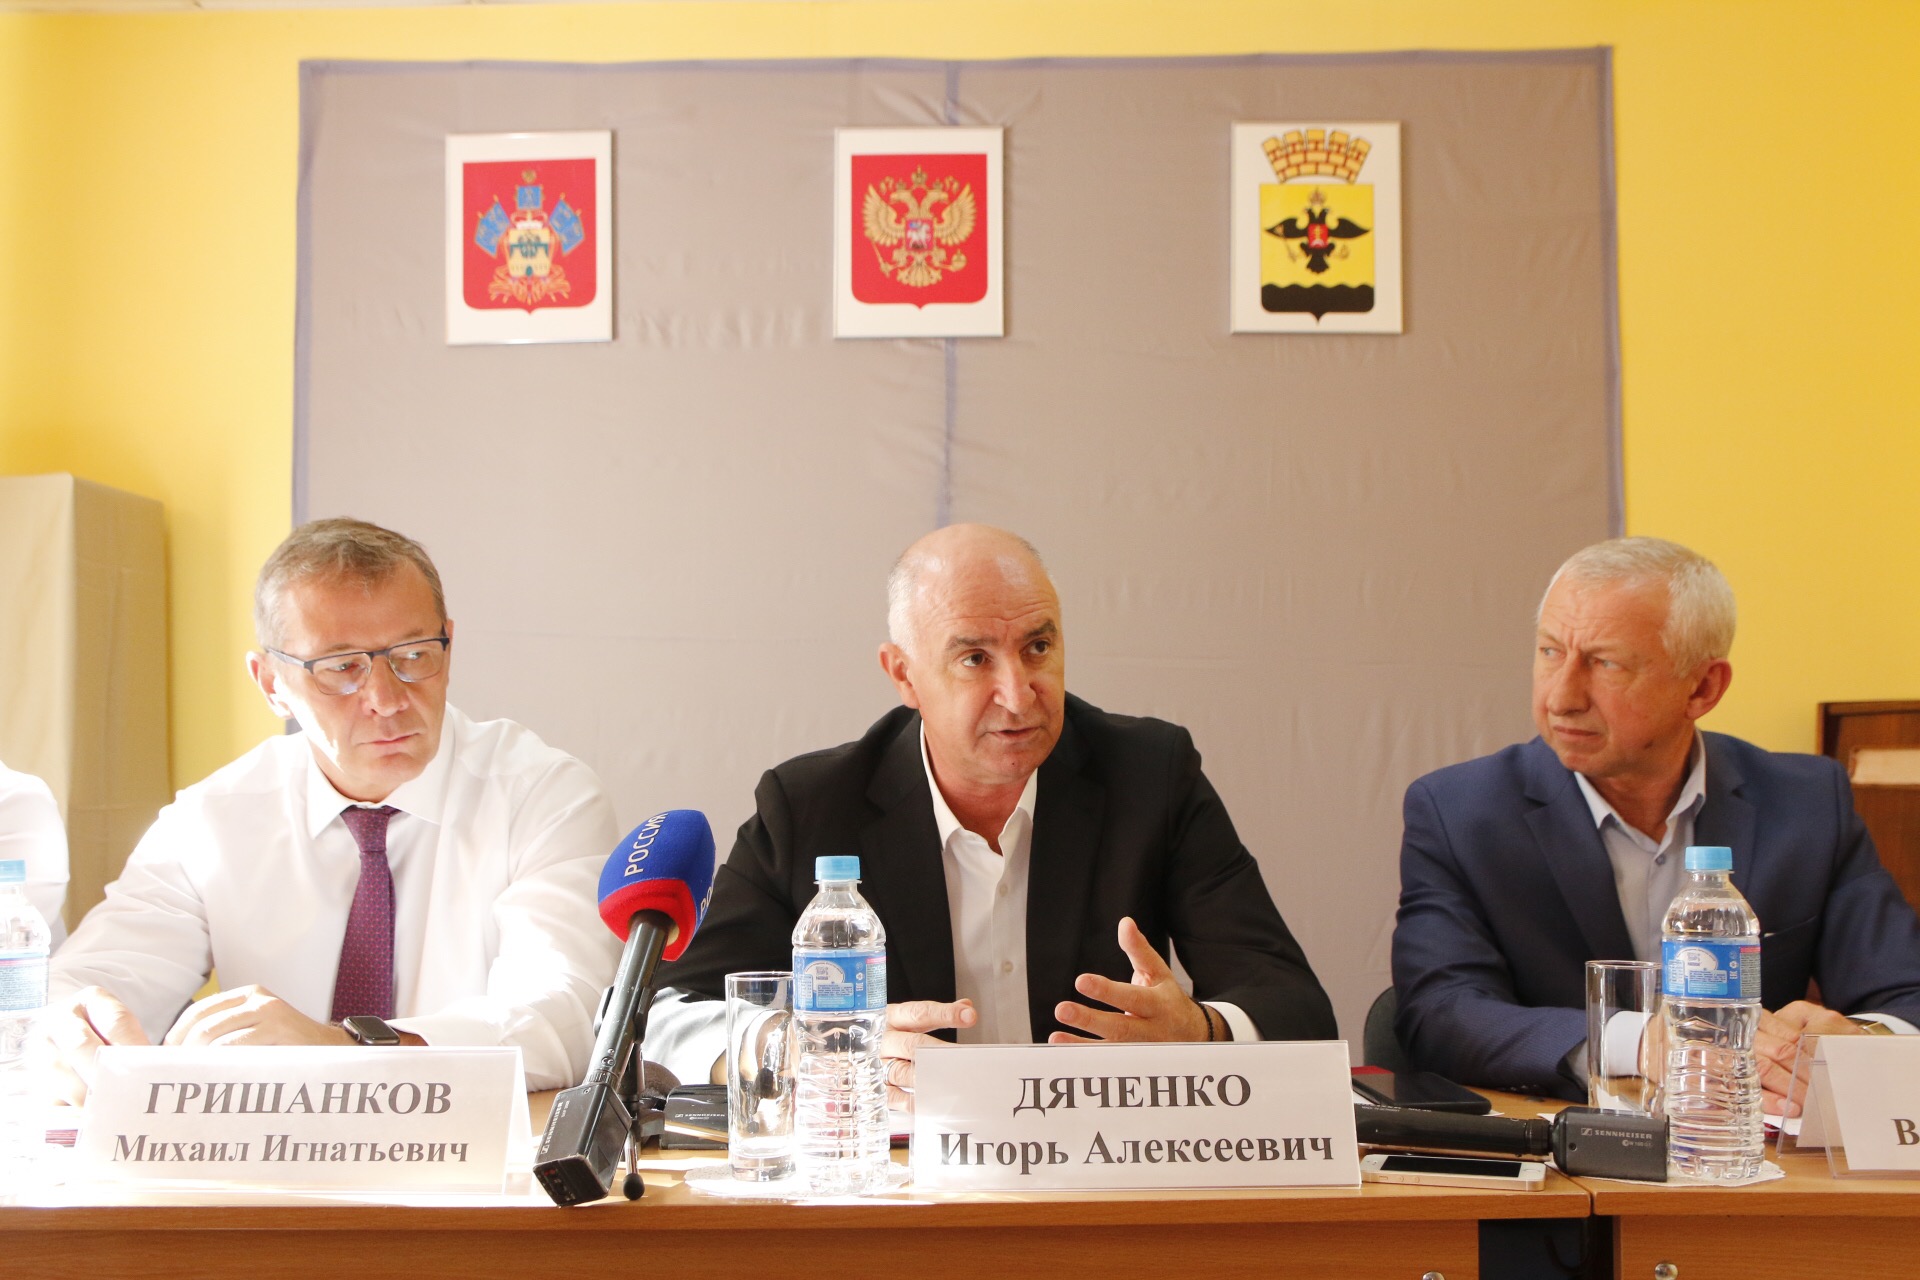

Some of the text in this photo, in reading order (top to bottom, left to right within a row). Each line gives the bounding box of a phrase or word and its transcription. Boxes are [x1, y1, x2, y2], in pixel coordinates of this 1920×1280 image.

[624, 813, 668, 877] РОССИЯ
[143, 1082, 452, 1114] ГРИШАНКОВ
[1013, 1074, 1251, 1118] ДЯЧЕНКО
[111, 1134, 470, 1162] Михаил Игнатьевич
[937, 1131, 1334, 1175] Игорь Алексеевич
[1594, 1129, 1653, 1140] SENNHEISER
